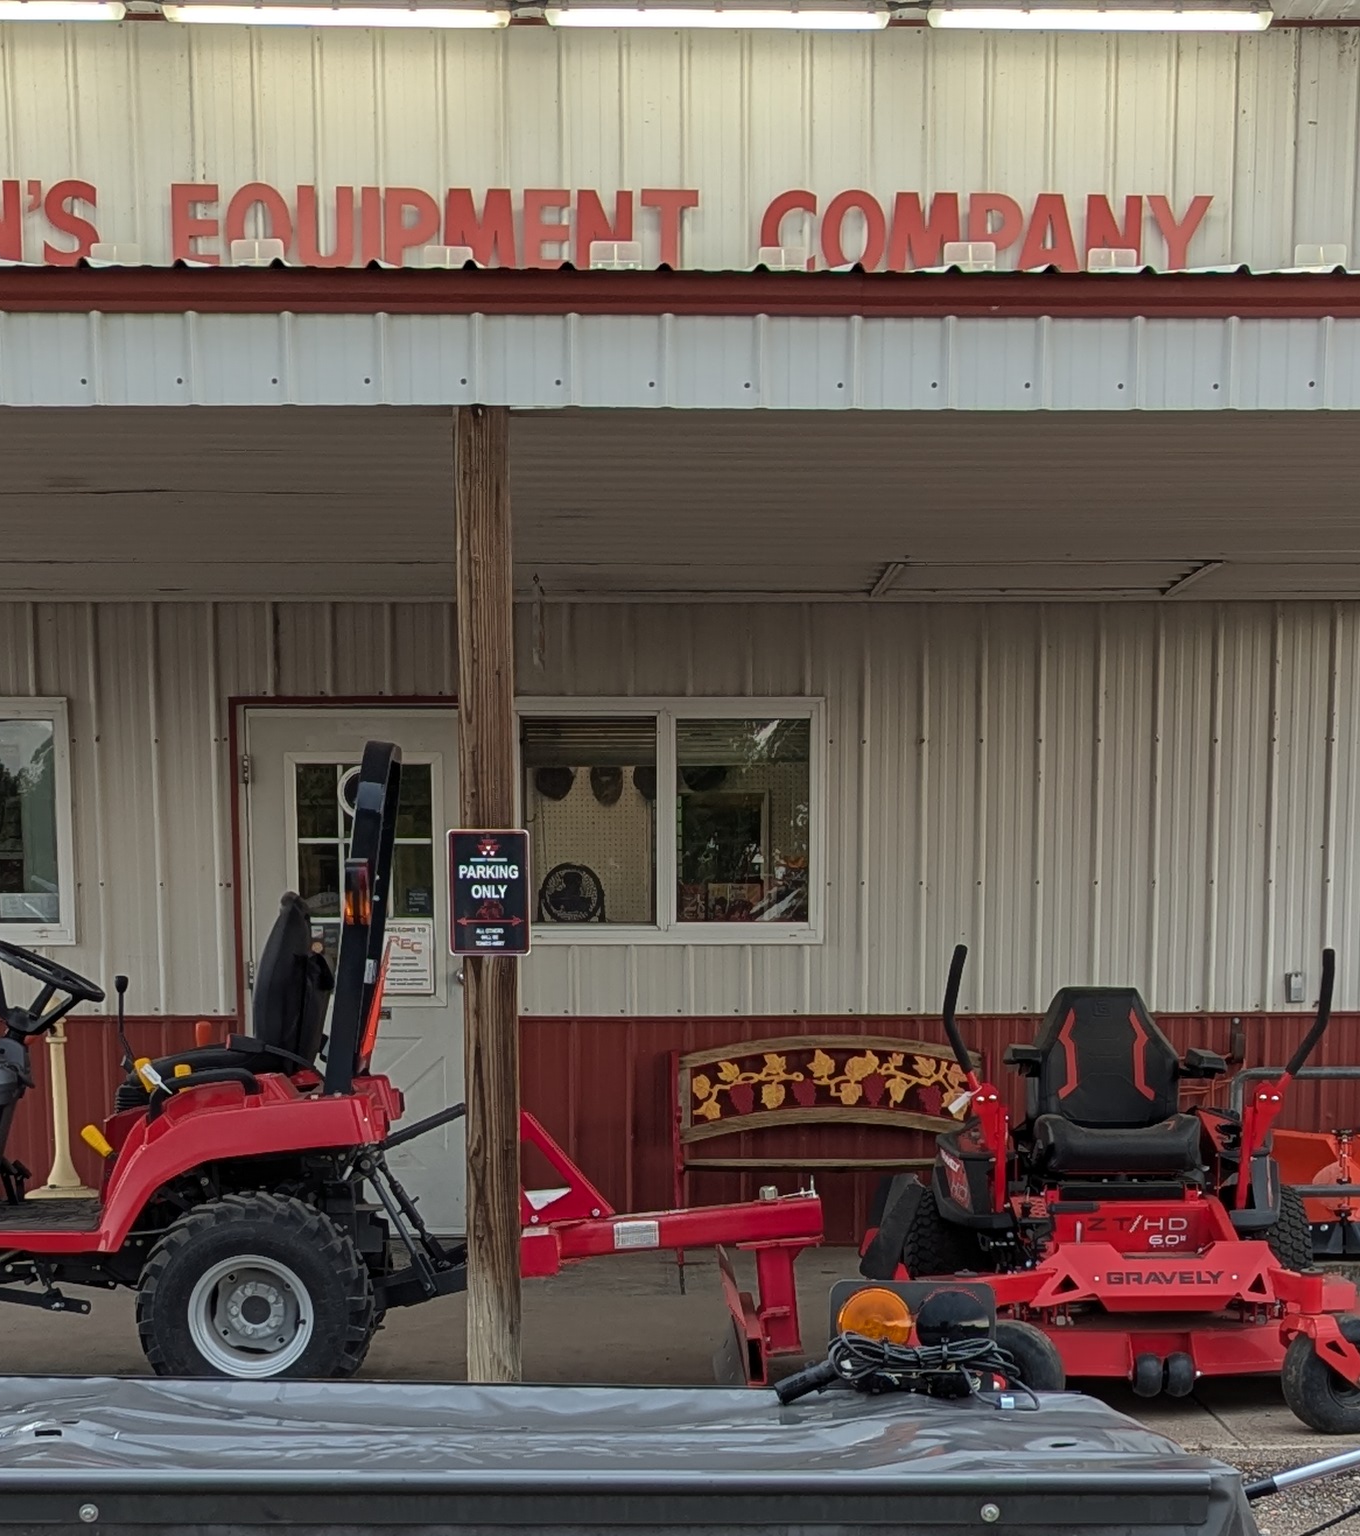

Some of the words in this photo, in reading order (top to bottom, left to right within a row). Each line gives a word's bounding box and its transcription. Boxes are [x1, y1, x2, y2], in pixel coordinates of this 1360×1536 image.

[171, 181, 699, 270] EQUIPMENT
[760, 189, 1215, 272] COMPANY
[458, 865, 520, 879] PARKING
[471, 885, 508, 898] ONLY
[1105, 1270, 1225, 1286] GRAVELY
